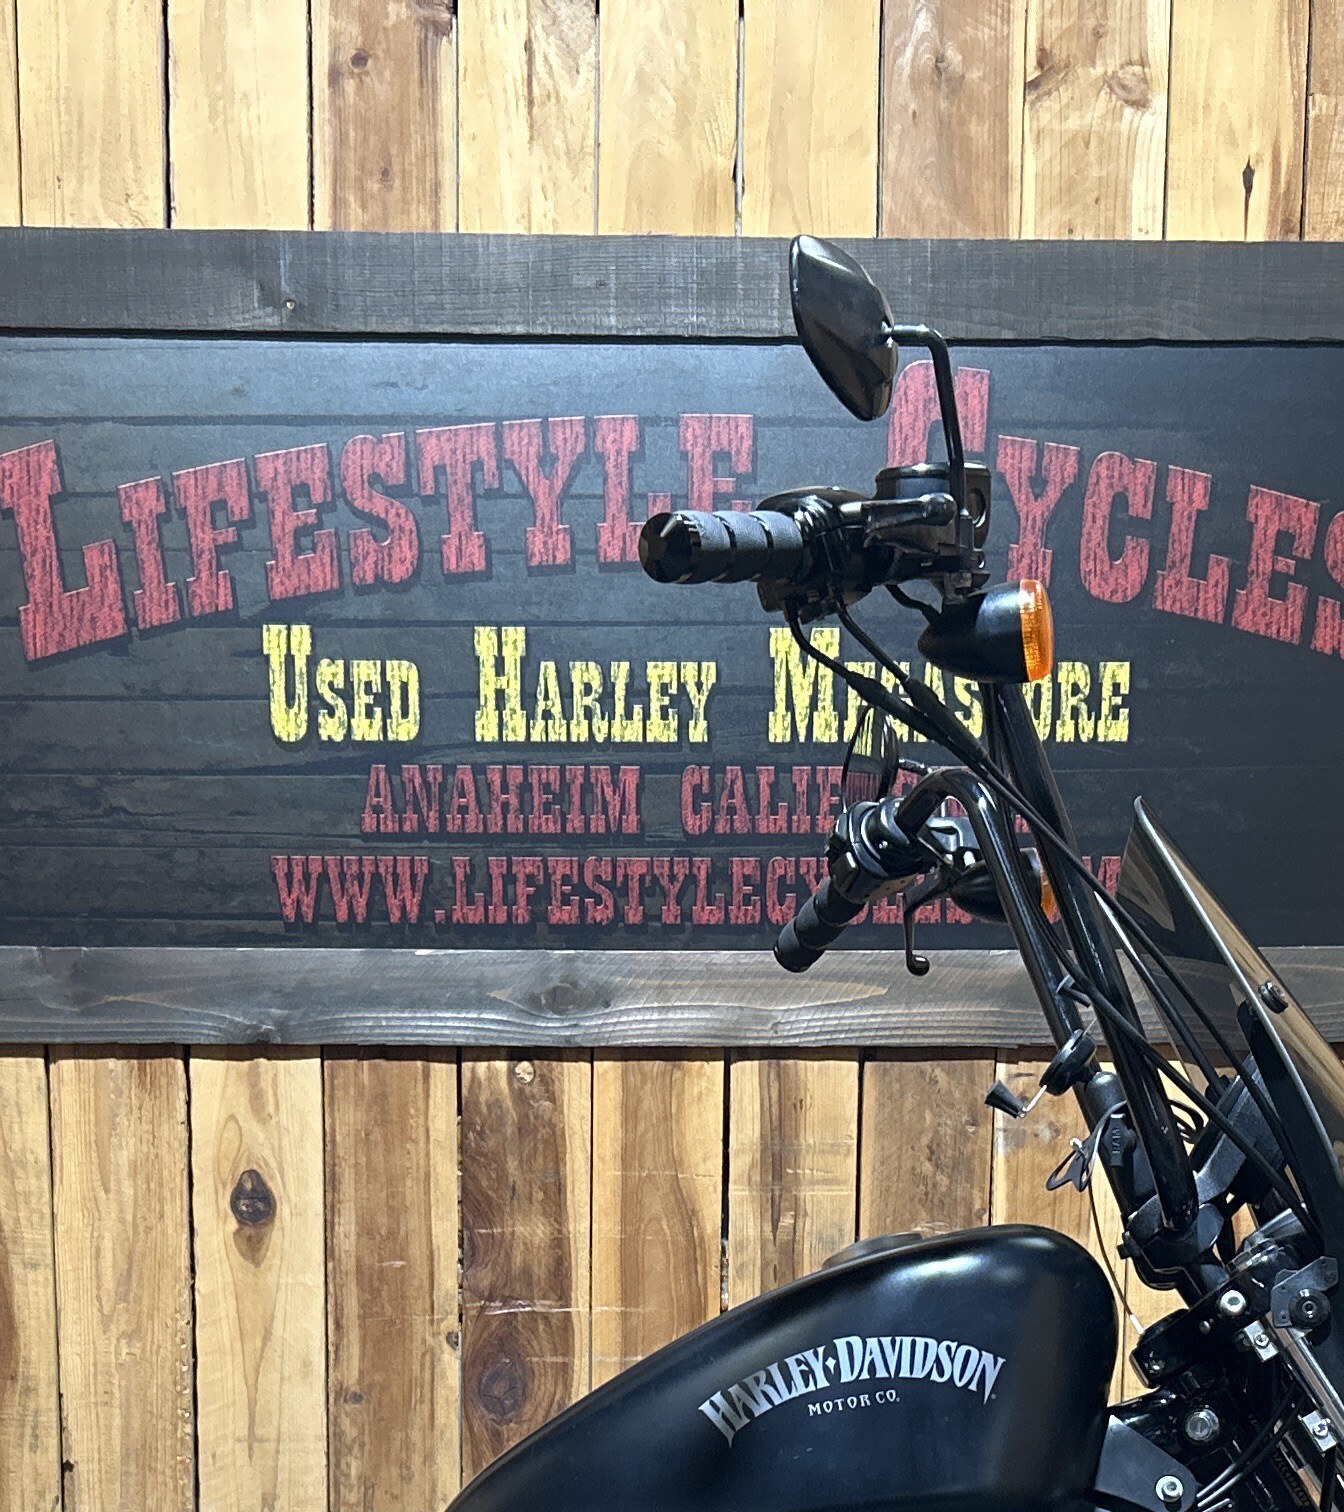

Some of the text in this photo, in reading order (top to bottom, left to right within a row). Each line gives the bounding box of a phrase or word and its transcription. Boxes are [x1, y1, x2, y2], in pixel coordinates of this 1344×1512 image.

[262, 624, 421, 743] USED
[473, 626, 717, 743] HARLEY
[360, 764, 642, 834] ANAHEIM
[808, 1394, 871, 1417] MOTOR
